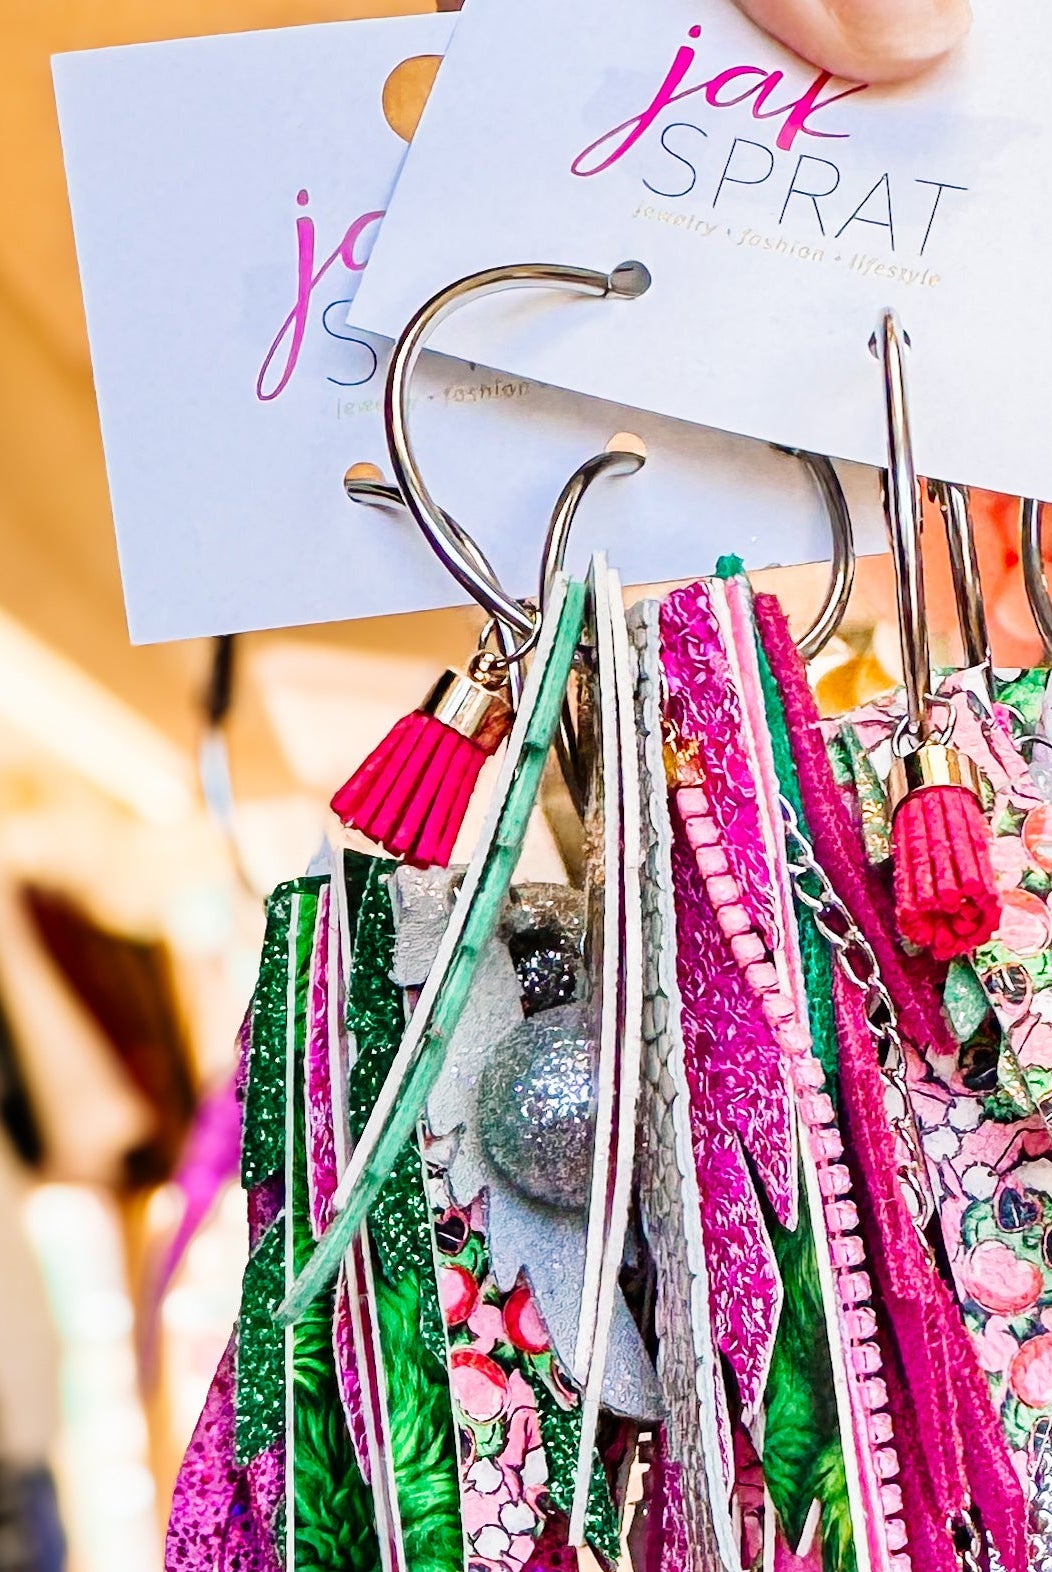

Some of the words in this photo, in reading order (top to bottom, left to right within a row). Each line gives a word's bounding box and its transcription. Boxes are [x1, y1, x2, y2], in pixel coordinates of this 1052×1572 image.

[571, 24, 869, 177] jak
[632, 200, 718, 236] jewelry
[736, 227, 825, 263] fashion
[848, 253, 943, 288] lifestyle
[642, 122, 969, 256] SPRAT
[256, 189, 387, 400] ja
